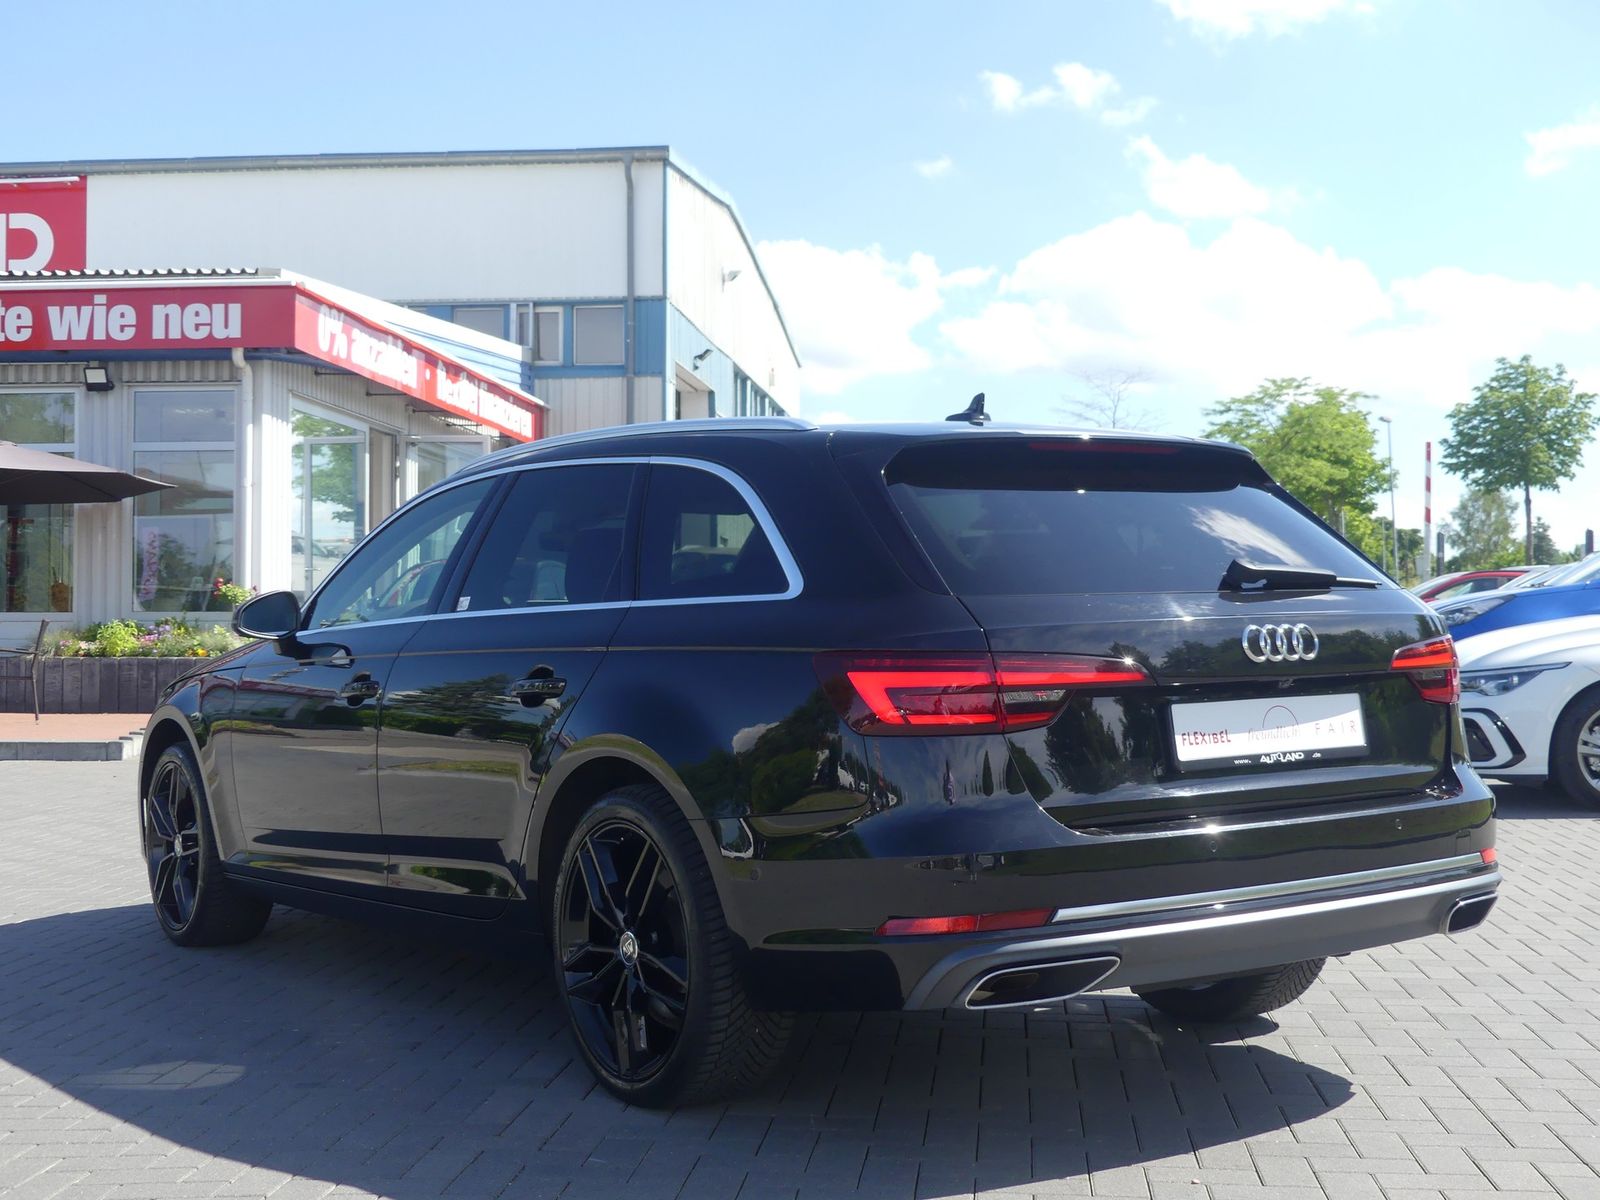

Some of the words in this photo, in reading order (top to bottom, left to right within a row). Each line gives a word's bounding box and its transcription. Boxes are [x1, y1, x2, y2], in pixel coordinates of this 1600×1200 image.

[47, 294, 136, 341] wie
[152, 303, 241, 339] neu
[317, 303, 348, 359] 0%
[1260, 751, 1304, 764] AUTOLAND
